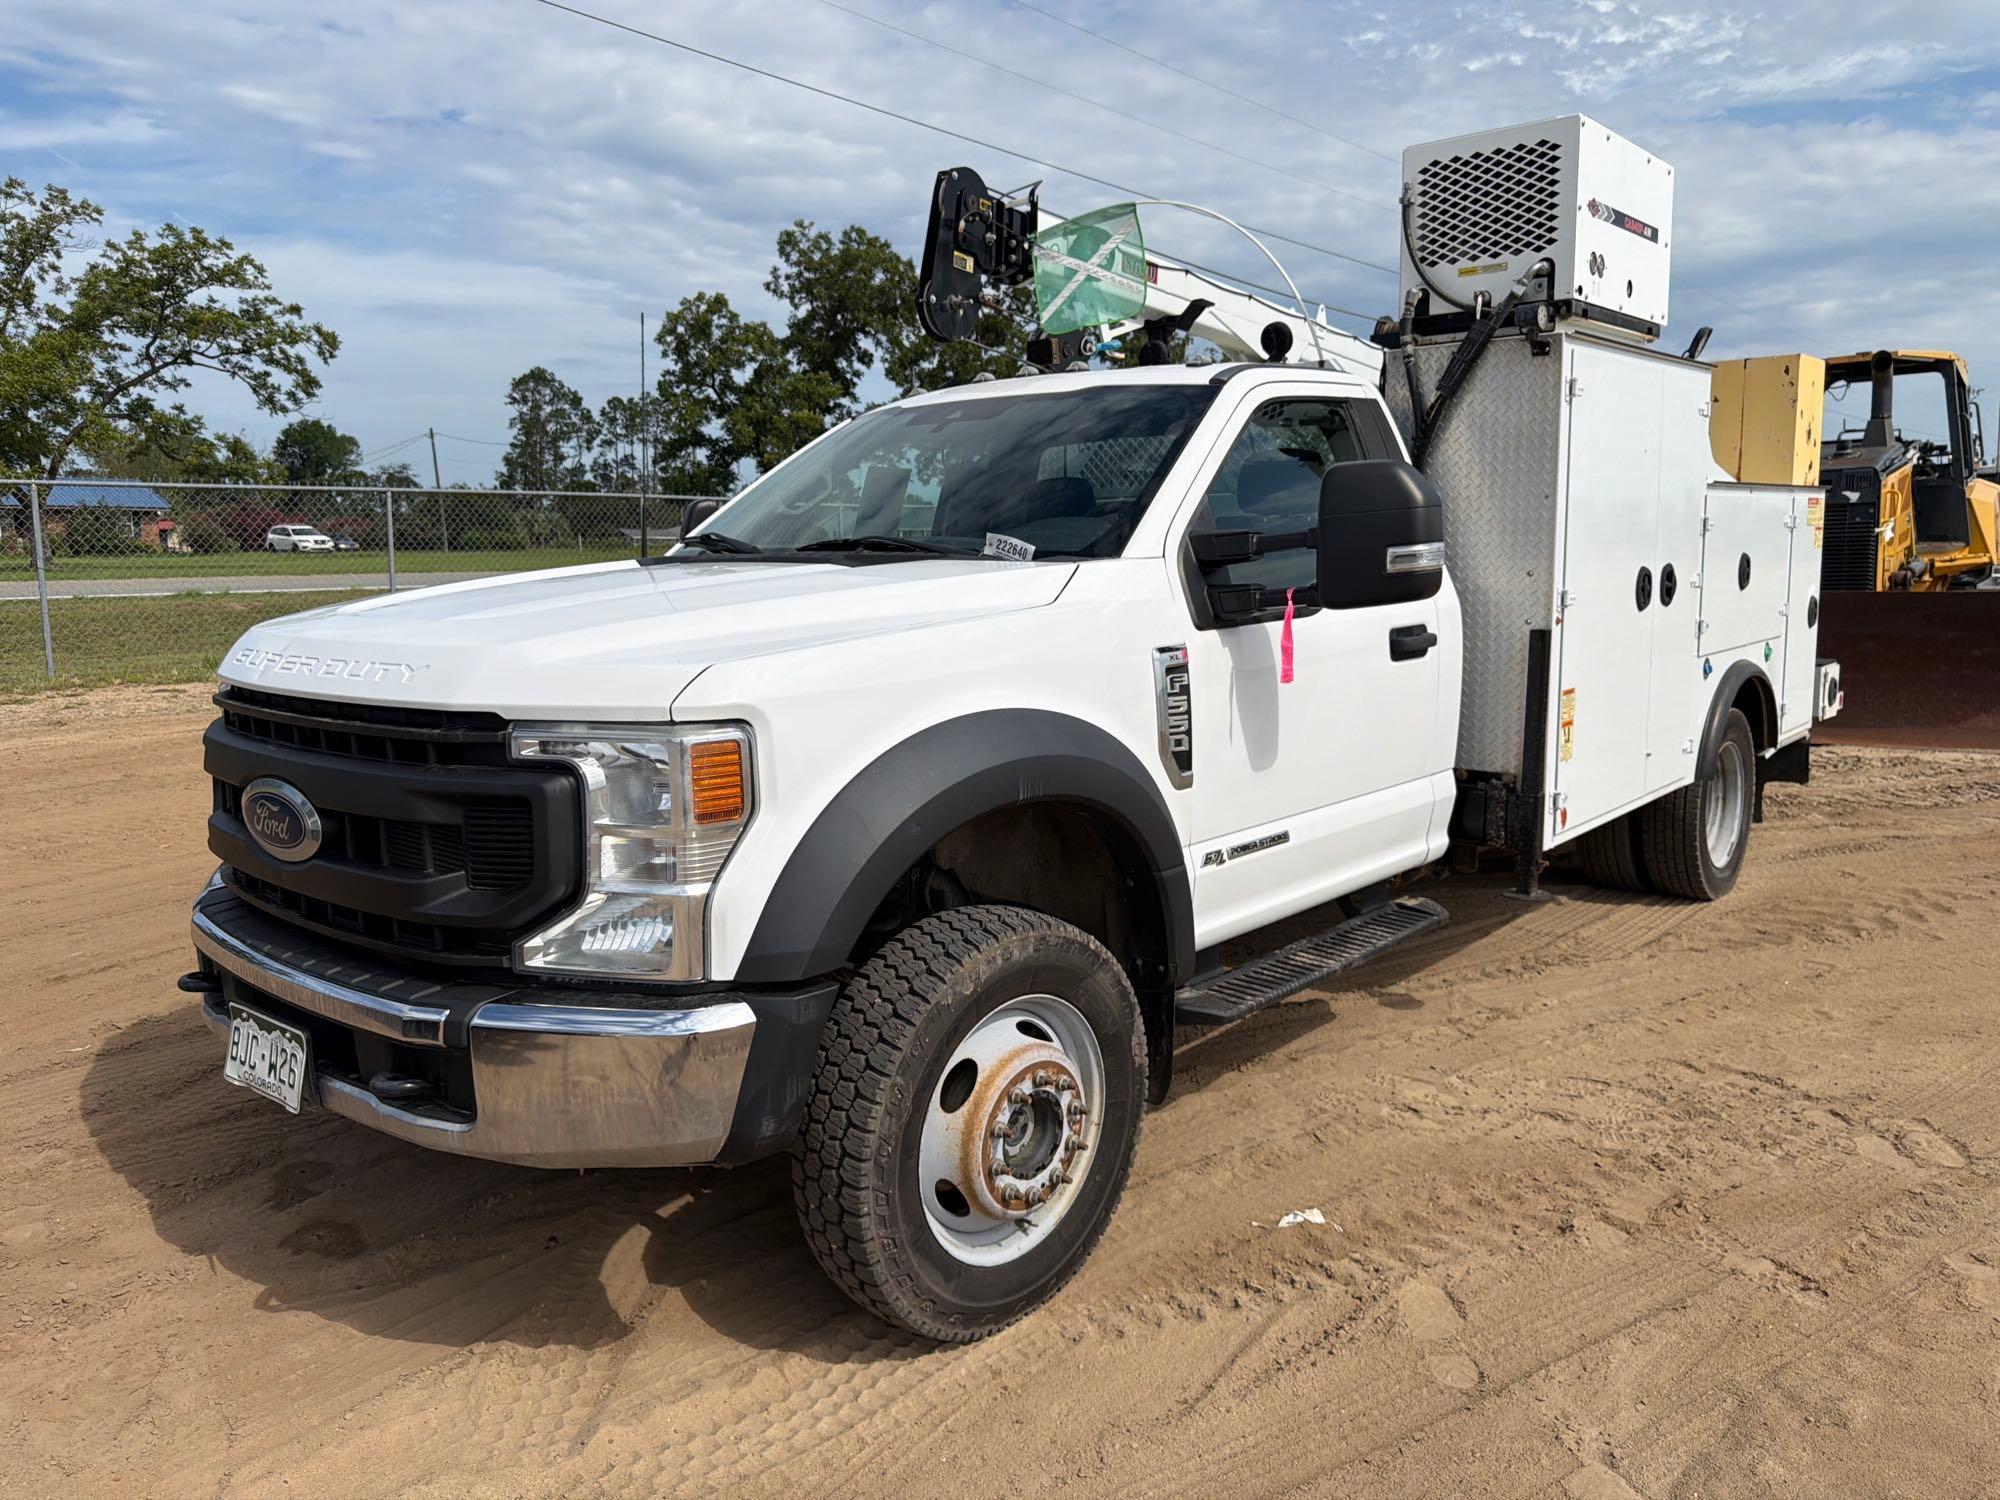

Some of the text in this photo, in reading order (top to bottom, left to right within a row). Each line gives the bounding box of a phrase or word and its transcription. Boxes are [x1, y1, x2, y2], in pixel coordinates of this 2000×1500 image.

[996, 538, 1028, 560] 222640
[233, 648, 431, 685] SUPER DUTY
[254, 799, 290, 840] Ford
[1230, 841, 1258, 856] POWER
[1259, 832, 1289, 847] STROKE
[243, 1070, 283, 1096] COLORADO
